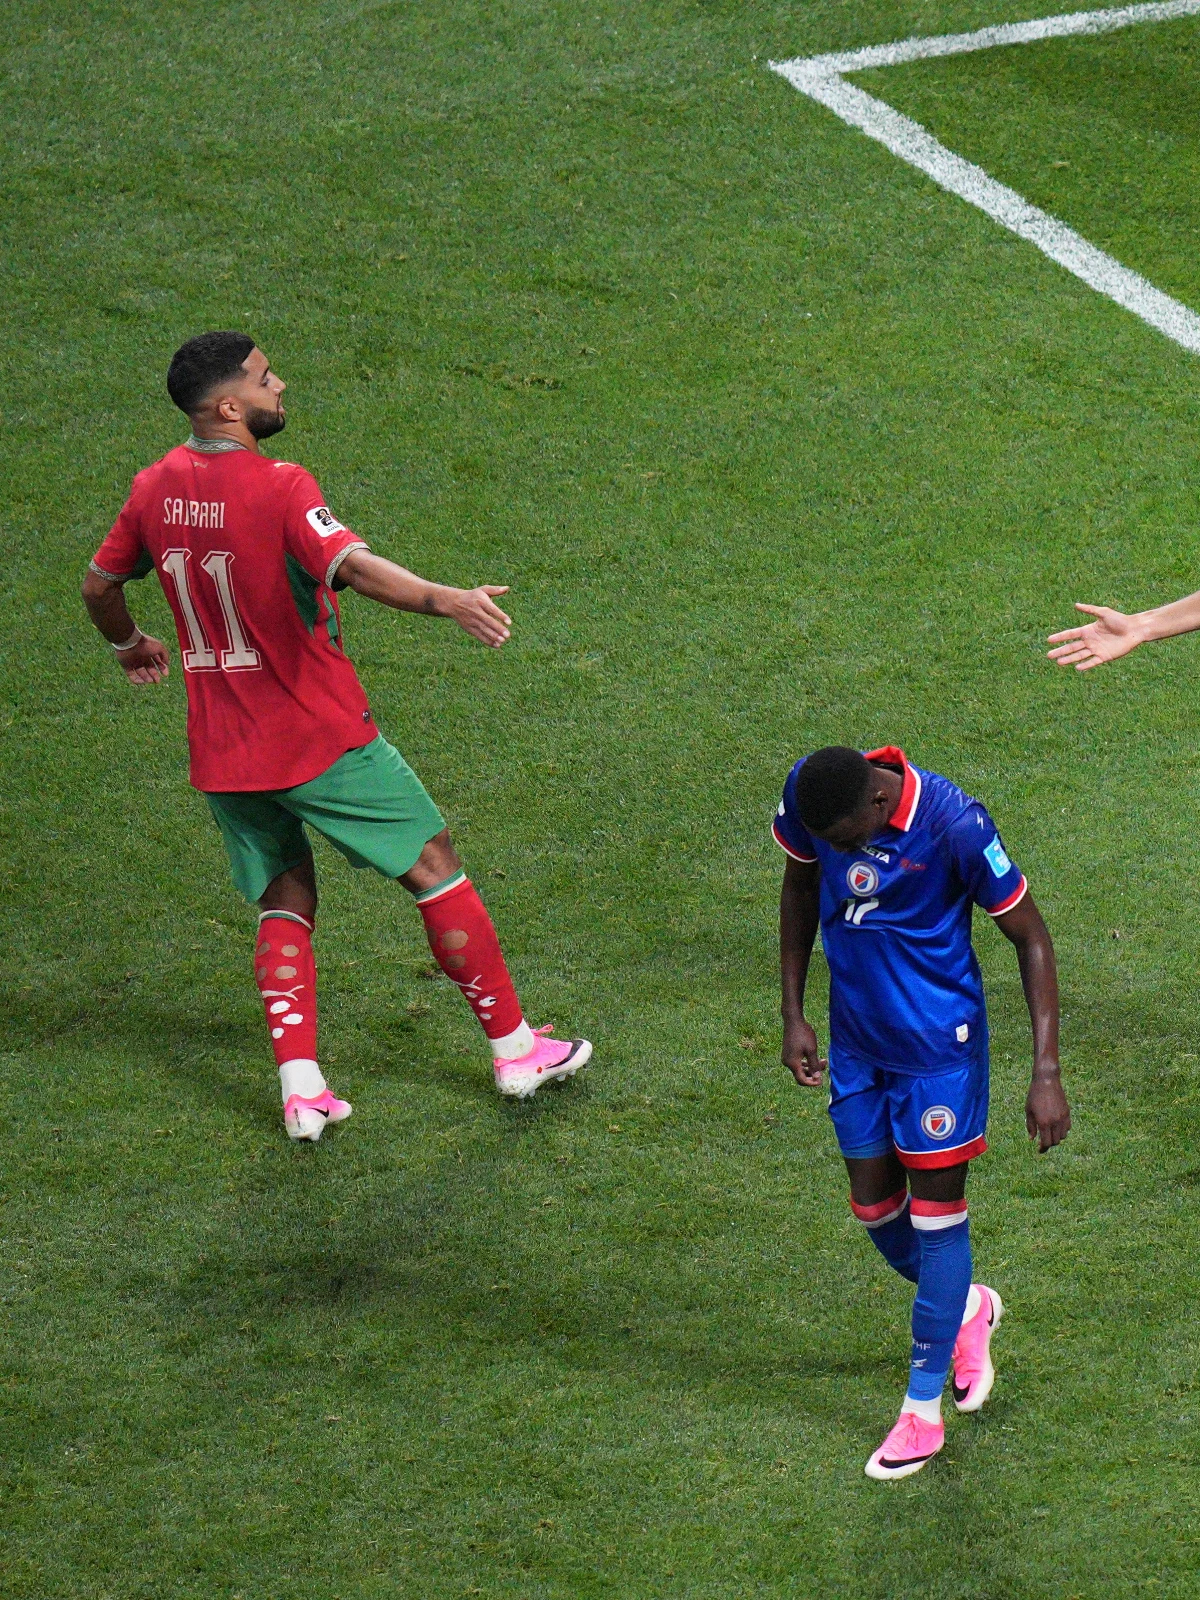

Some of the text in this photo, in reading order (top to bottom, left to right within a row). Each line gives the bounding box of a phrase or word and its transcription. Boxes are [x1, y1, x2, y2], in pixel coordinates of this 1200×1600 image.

[163, 497, 225, 529] SAIBARI
[161, 547, 262, 673] 11
[861, 845, 890, 864] AETA
